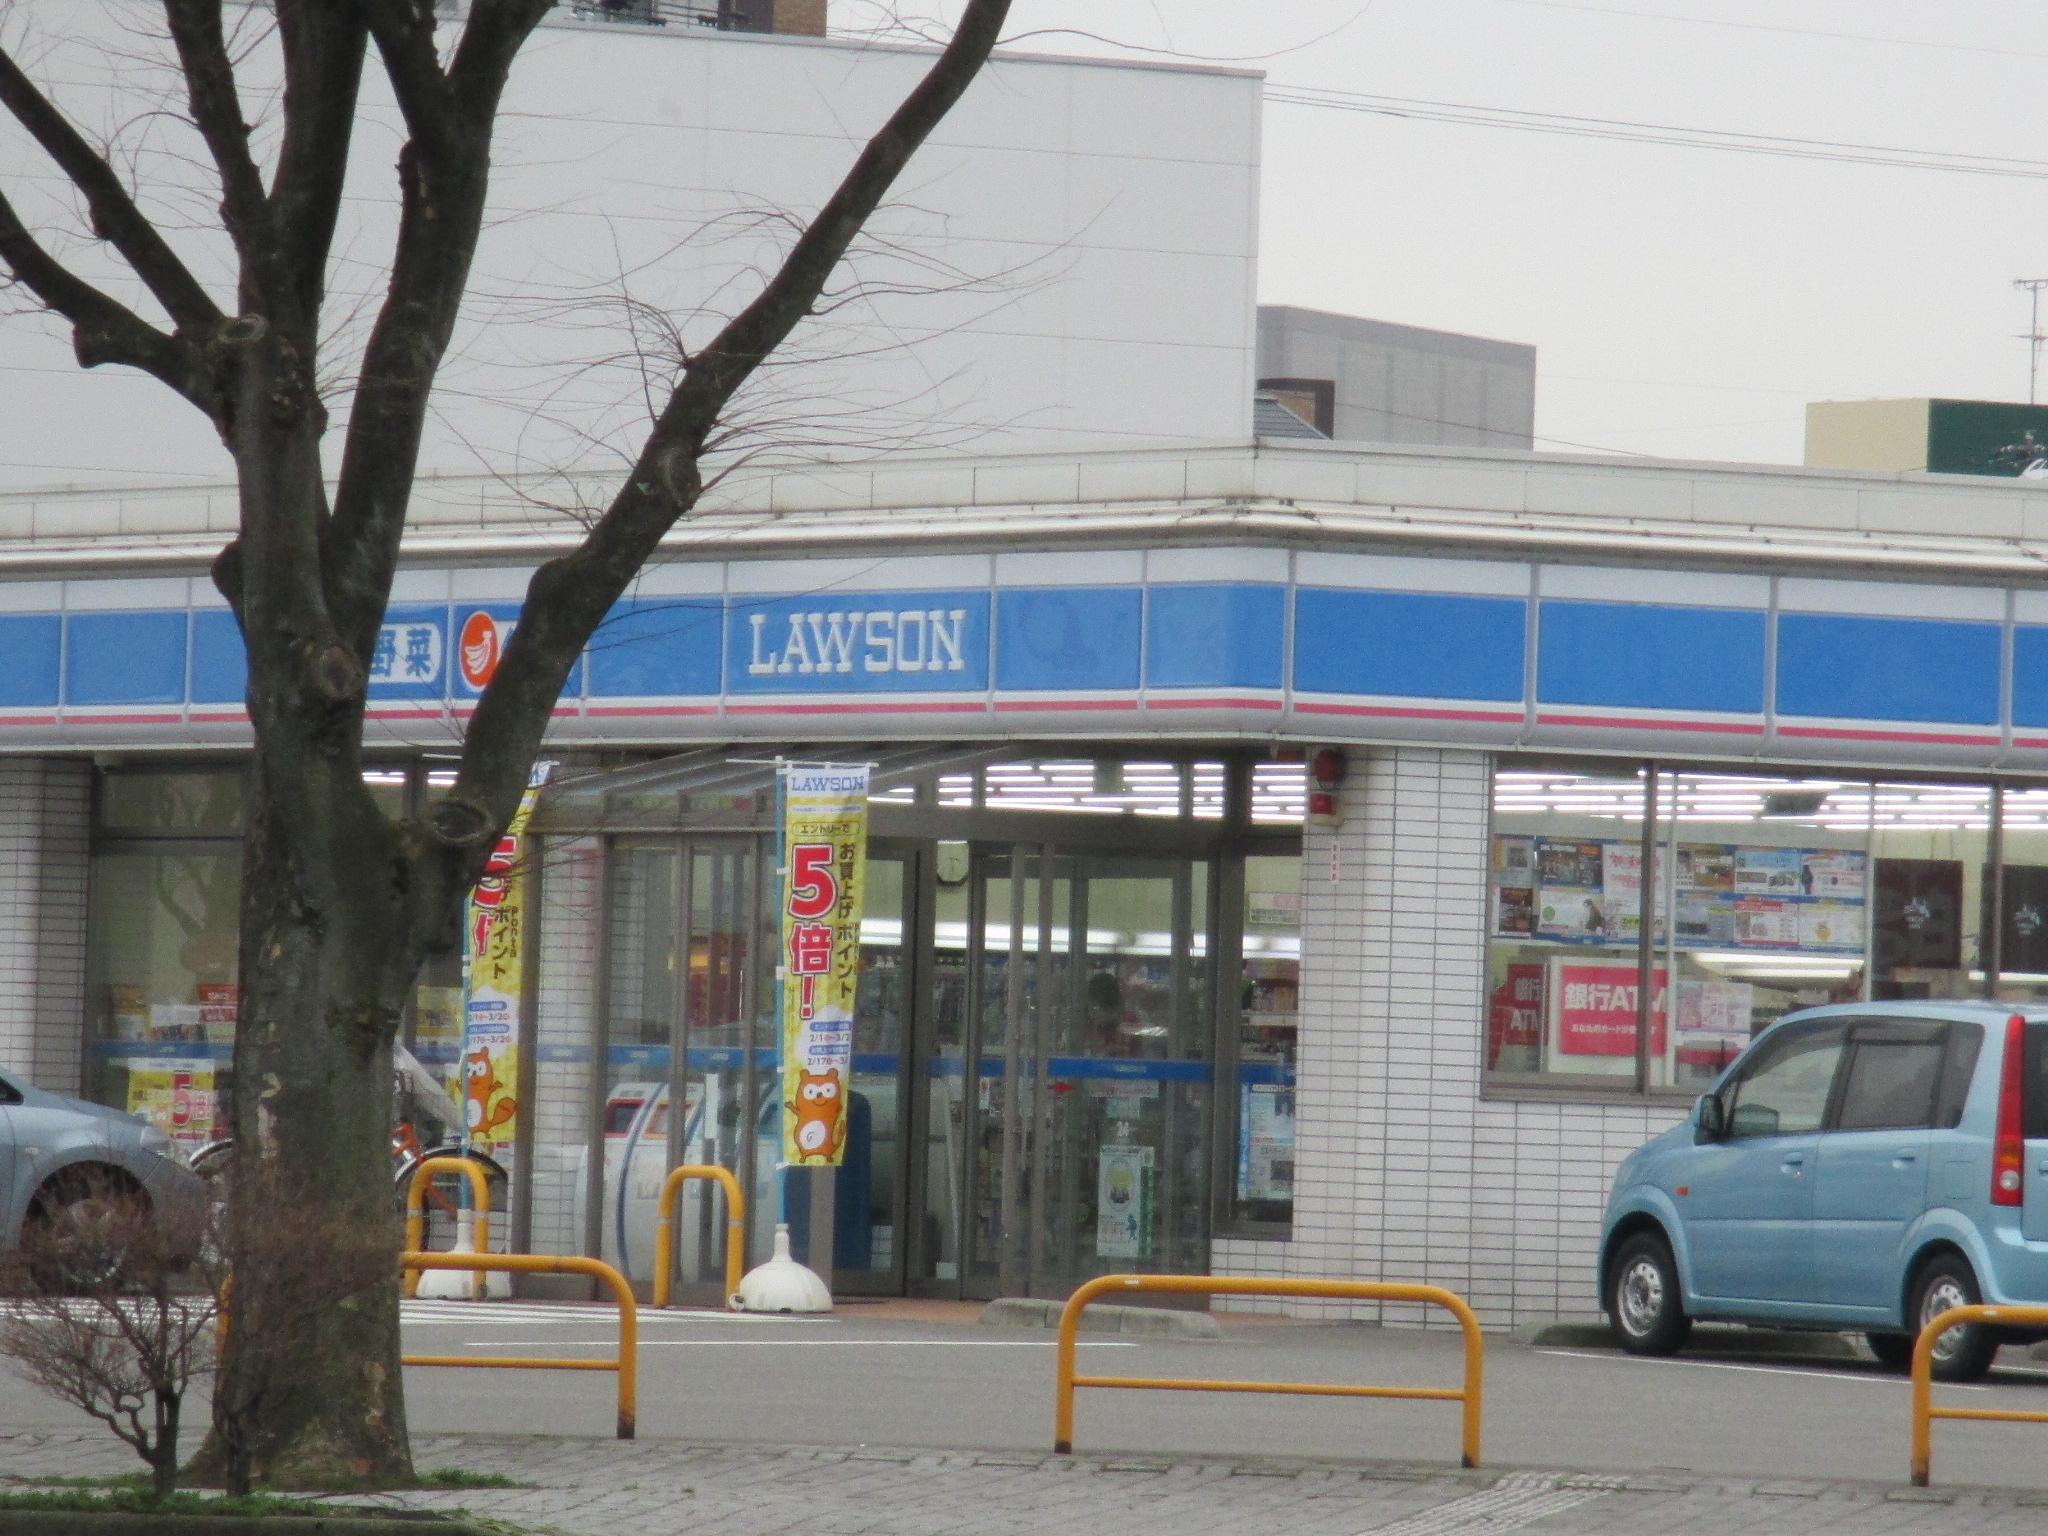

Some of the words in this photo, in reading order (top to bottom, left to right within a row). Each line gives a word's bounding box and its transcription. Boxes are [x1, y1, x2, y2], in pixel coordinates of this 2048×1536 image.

[749, 609, 967, 675] LAWSON
[791, 776, 865, 792] LAWSON
[800, 823, 850, 834] エントリーで
